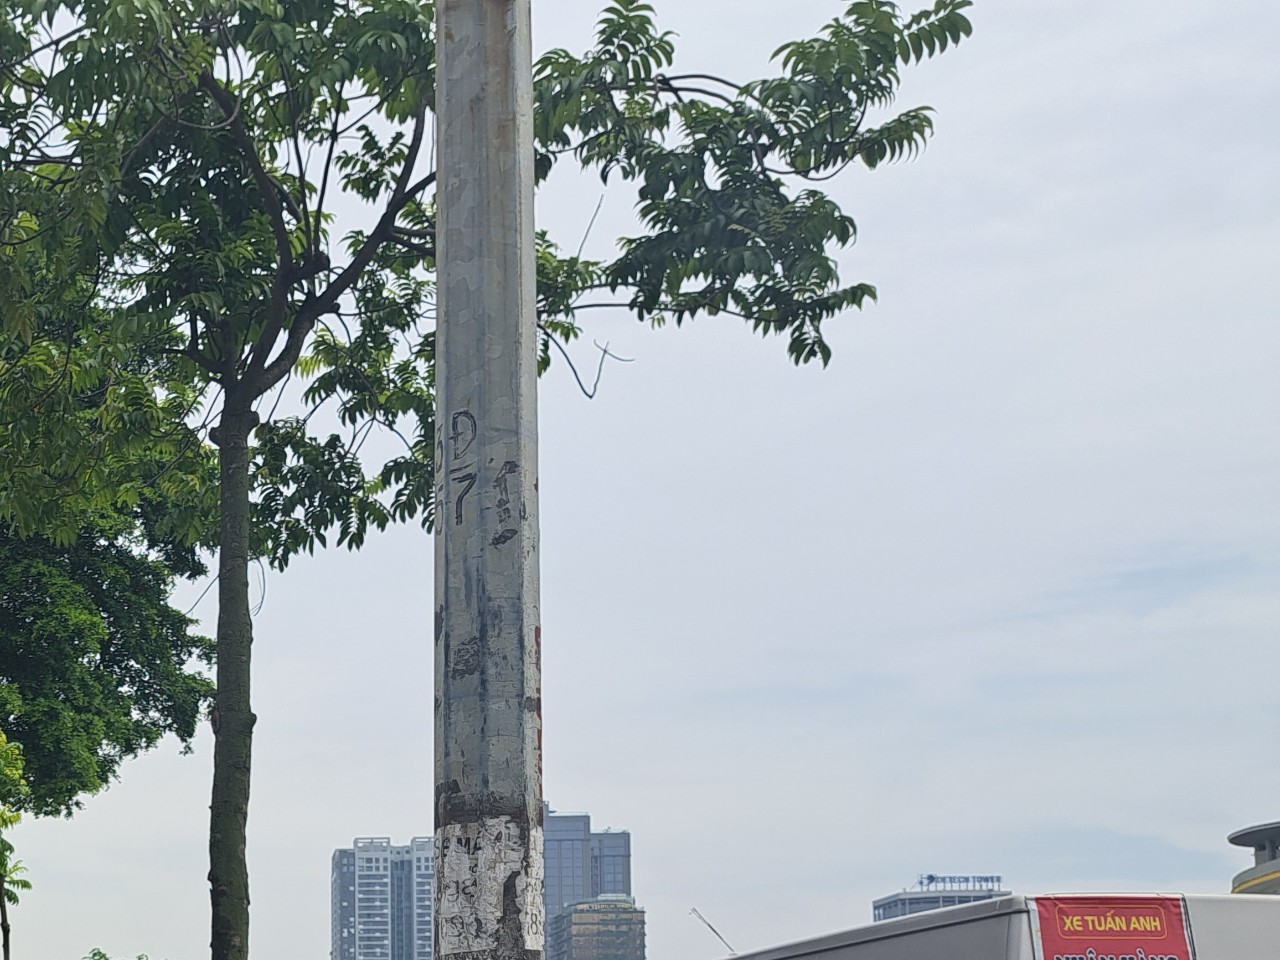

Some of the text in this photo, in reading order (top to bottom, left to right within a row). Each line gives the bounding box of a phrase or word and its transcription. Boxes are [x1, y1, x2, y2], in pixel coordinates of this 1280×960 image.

[1063, 910, 1161, 931] XE TUẤN ANH
